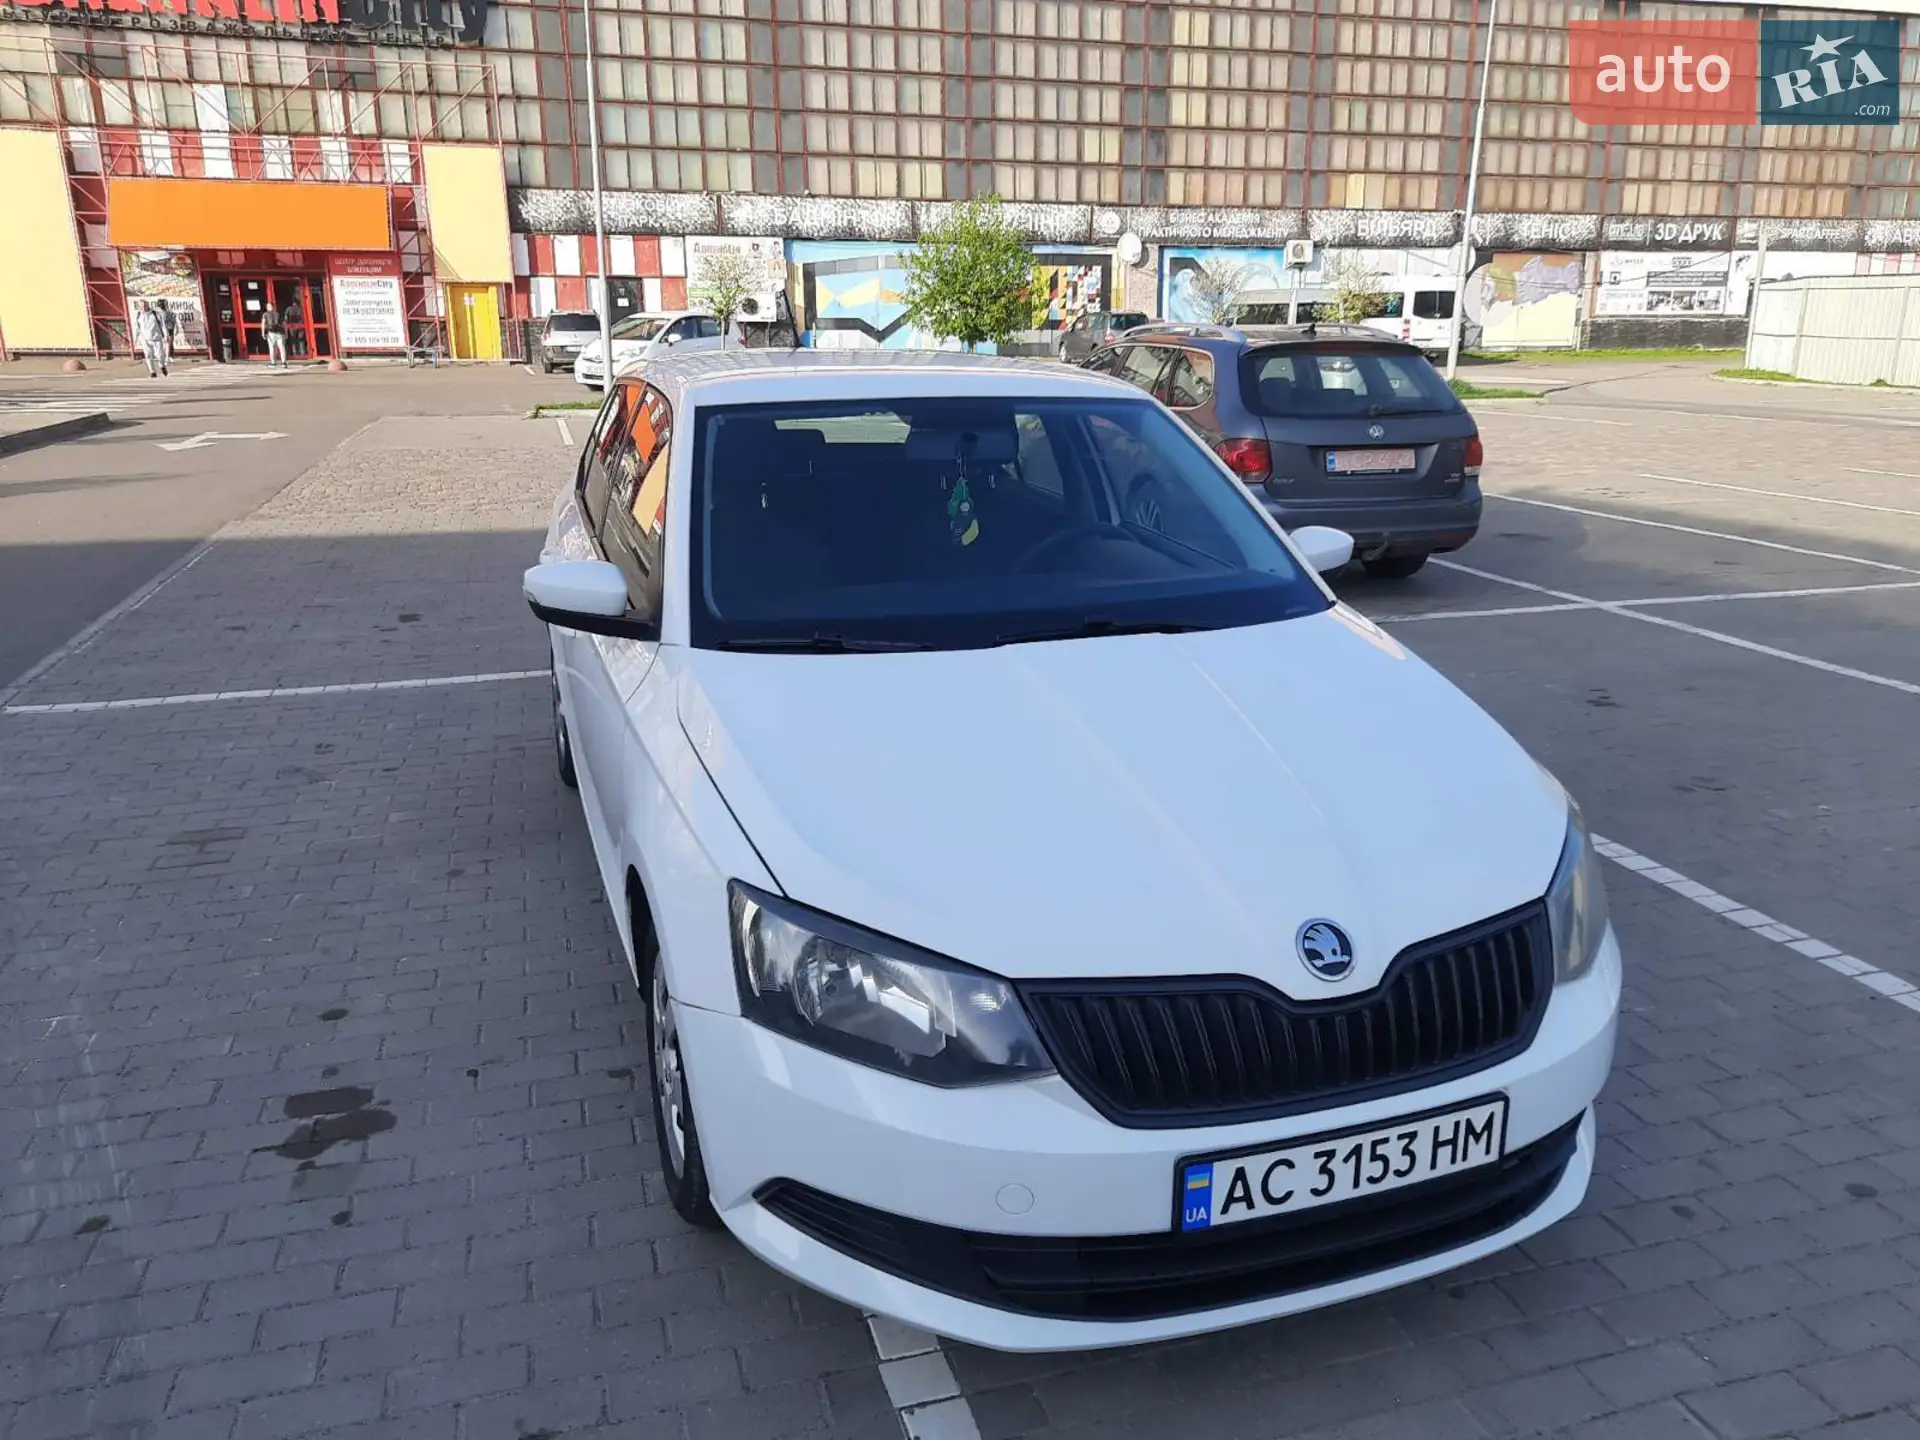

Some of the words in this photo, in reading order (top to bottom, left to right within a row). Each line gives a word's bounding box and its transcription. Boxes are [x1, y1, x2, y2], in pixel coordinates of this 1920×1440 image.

[1655, 222, 1676, 241] 3D
[1678, 220, 1724, 243] ДРУК
[1220, 1158, 1296, 1215] AC
[1310, 1130, 1418, 1197] 3153
[1429, 1111, 1495, 1170] HM
[1185, 1207, 1208, 1223] UA
